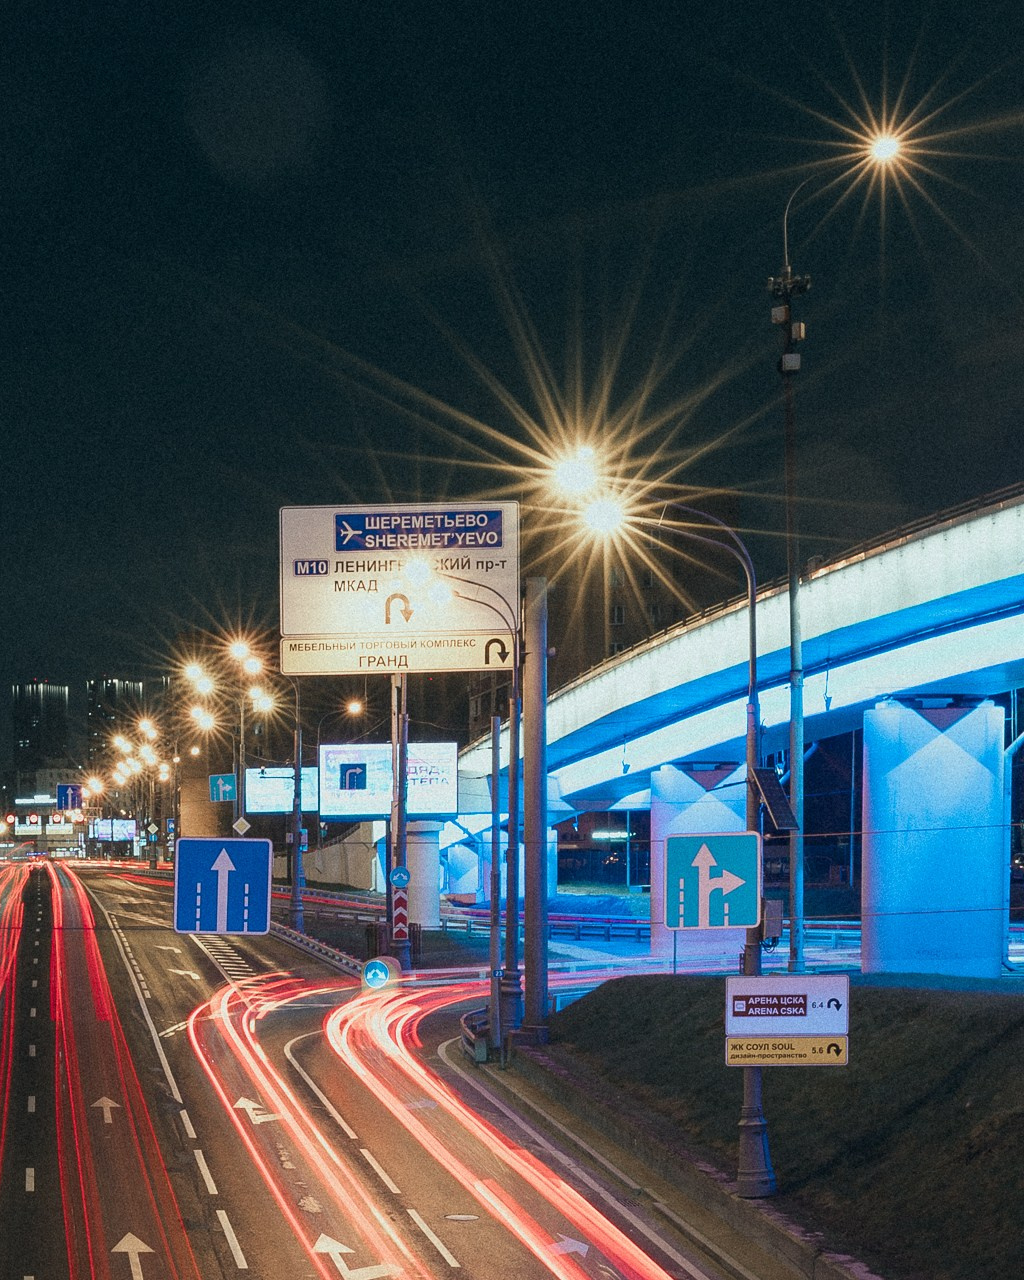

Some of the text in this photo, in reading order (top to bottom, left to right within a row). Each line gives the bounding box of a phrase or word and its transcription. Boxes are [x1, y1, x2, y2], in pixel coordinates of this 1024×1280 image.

[364, 513, 489, 530] ШЕРЕМЕТЬЕВО
[364, 531, 499, 548] SHEREMET'YEVO
[476, 559, 508, 573] пр-т
[334, 579, 379, 593] МКАД
[289, 638, 477, 652] МЕБЕЛЬНЫЙ ТОРГОВЫЙ КОМПЛЕКС
[358, 655, 409, 669] ГРАНД
[780, 997, 804, 1005] ЦСКА
[811, 1001, 824, 1009] 6.4
[730, 1043, 795, 1051] ЖК СОУЛ SOUL
[811, 1046, 824, 1054] 5.6
